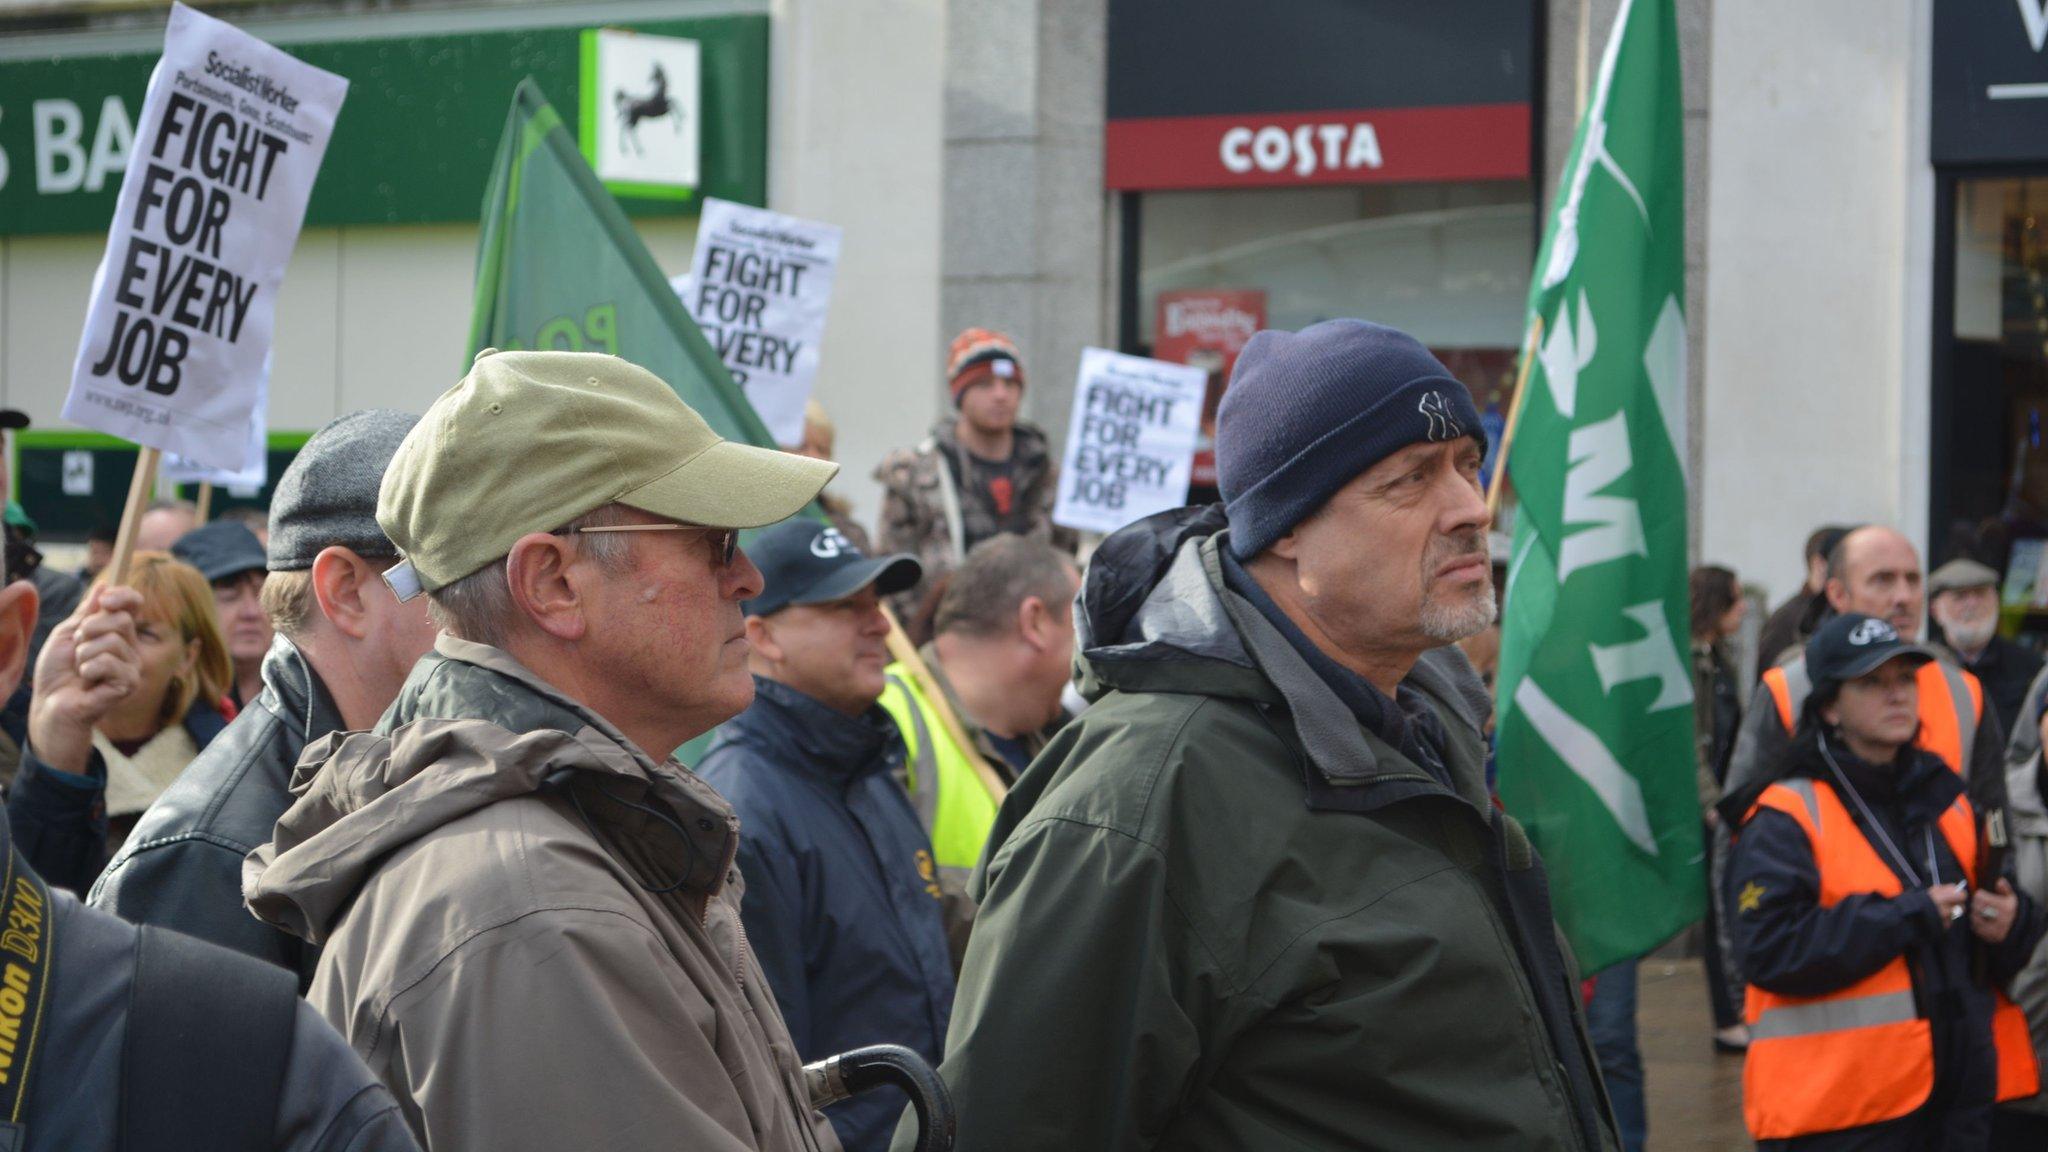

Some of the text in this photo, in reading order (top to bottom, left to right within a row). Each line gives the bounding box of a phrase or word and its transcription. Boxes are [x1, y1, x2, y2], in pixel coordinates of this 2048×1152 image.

[32, 95, 137, 194] BA
[151, 91, 289, 201] FIGHT
[1219, 122, 1383, 177] COSTA
[132, 162, 230, 260] FOR
[115, 235, 259, 344] EVERY
[703, 246, 807, 297] FIGHT
[696, 284, 766, 328] FOR
[91, 310, 190, 397] JOB
[700, 323, 802, 376] VERY
[1080, 414, 1141, 449] FOR
[1085, 383, 1177, 427] FIGHT
[1070, 478, 1127, 509] JOB
[1073, 446, 1176, 487] EVERY
[1, 877, 42, 964] D300
